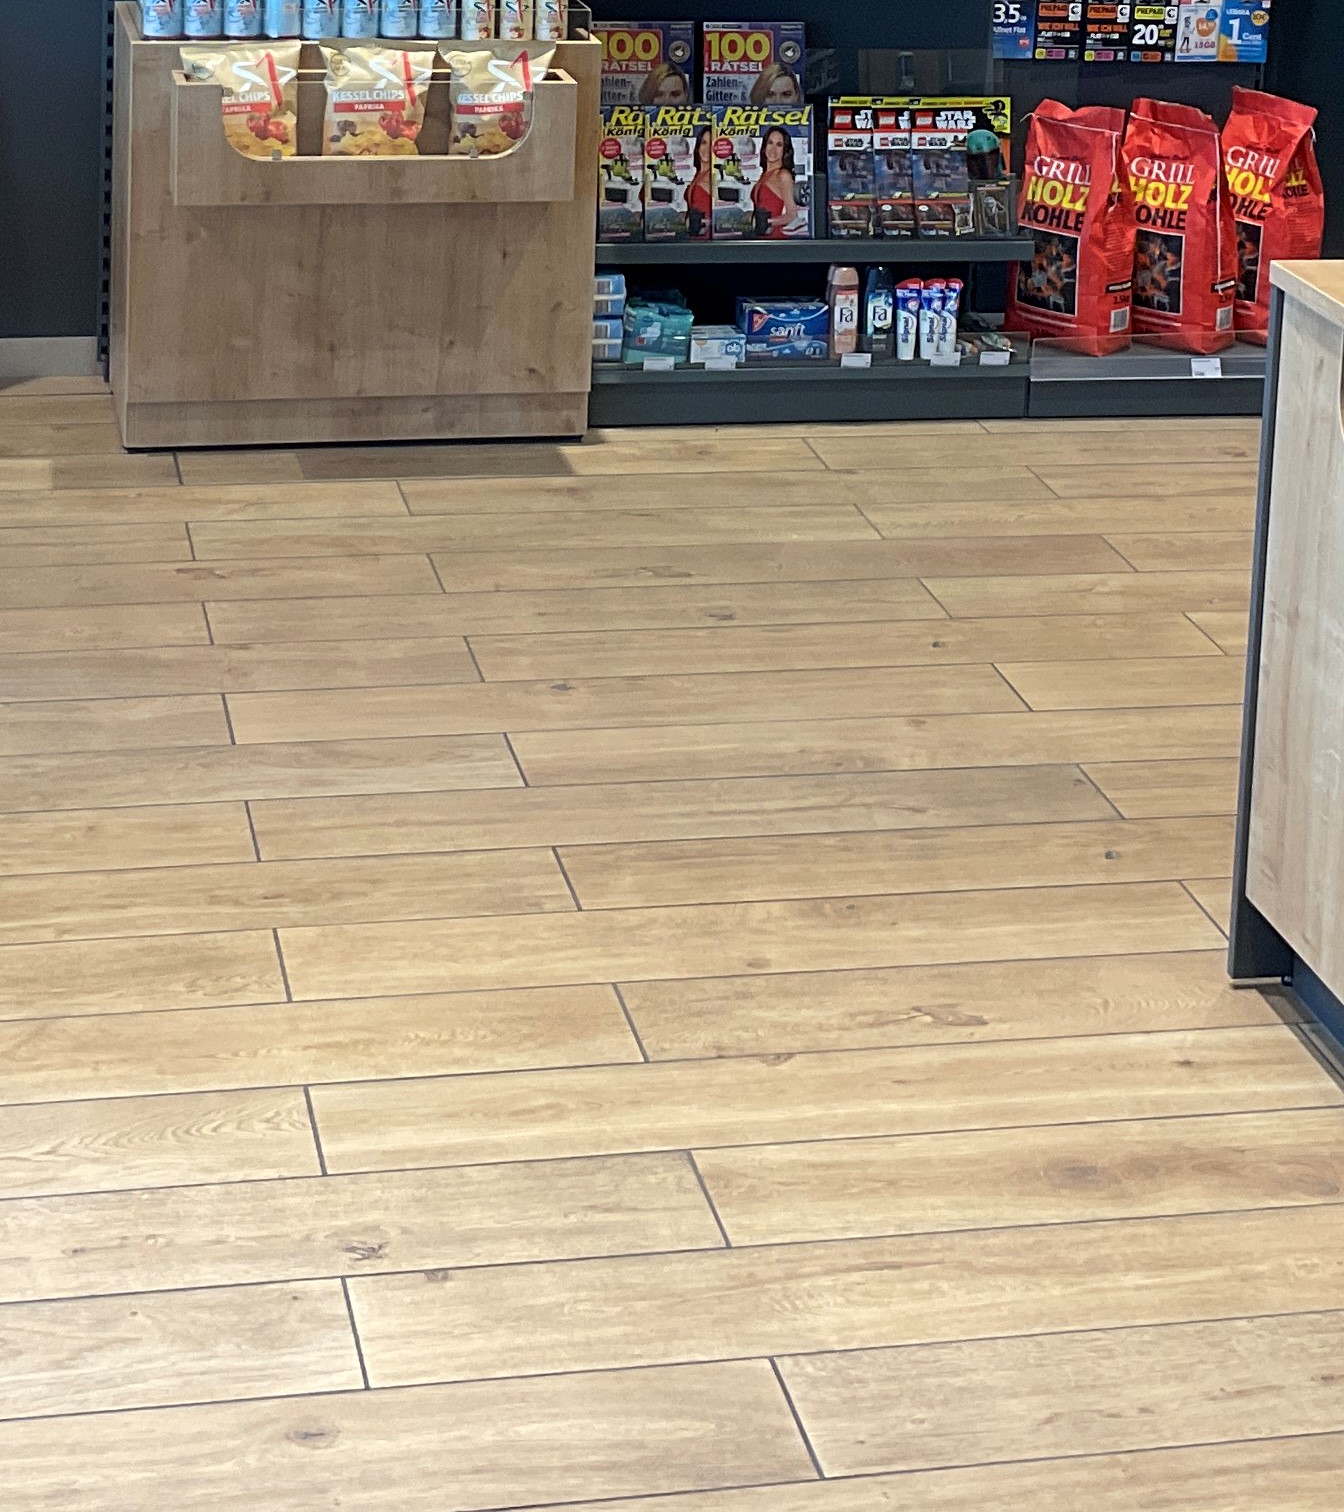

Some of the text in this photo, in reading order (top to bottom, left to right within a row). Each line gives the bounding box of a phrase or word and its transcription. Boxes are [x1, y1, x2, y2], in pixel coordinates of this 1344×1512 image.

[1132, 24, 1159, 45] 20
[1227, 18, 1242, 45] 1
[706, 32, 770, 61] 100
[242, 92, 270, 101] CHIPS
[332, 90, 405, 101] KESSEL CHIPS
[457, 91, 523, 103] KESSEL CHIPS
[354, 103, 385, 111] PAPRIKA
[474, 105, 504, 113] PAPRIKA
[723, 106, 809, 126] Rätsel
[939, 110, 974, 120] STAR
[653, 124, 692, 137] König
[719, 124, 758, 137] König
[936, 118, 975, 129] WARS
[1034, 155, 1091, 185] GRILL
[1130, 156, 1196, 185] GRILL
[1227, 145, 1281, 179] GRILL
[1027, 175, 1090, 211] HOLZ
[1021, 200, 1085, 232] KOHLE
[1135, 204, 1187, 230] OHLE
[840, 306, 854, 323] Fa
[872, 305, 887, 322] Fa
[770, 322, 806, 338] sanft
[901, 316, 910, 343] Signal
[927, 316, 935, 343] Signal
[940, 316, 948, 343] Signal
